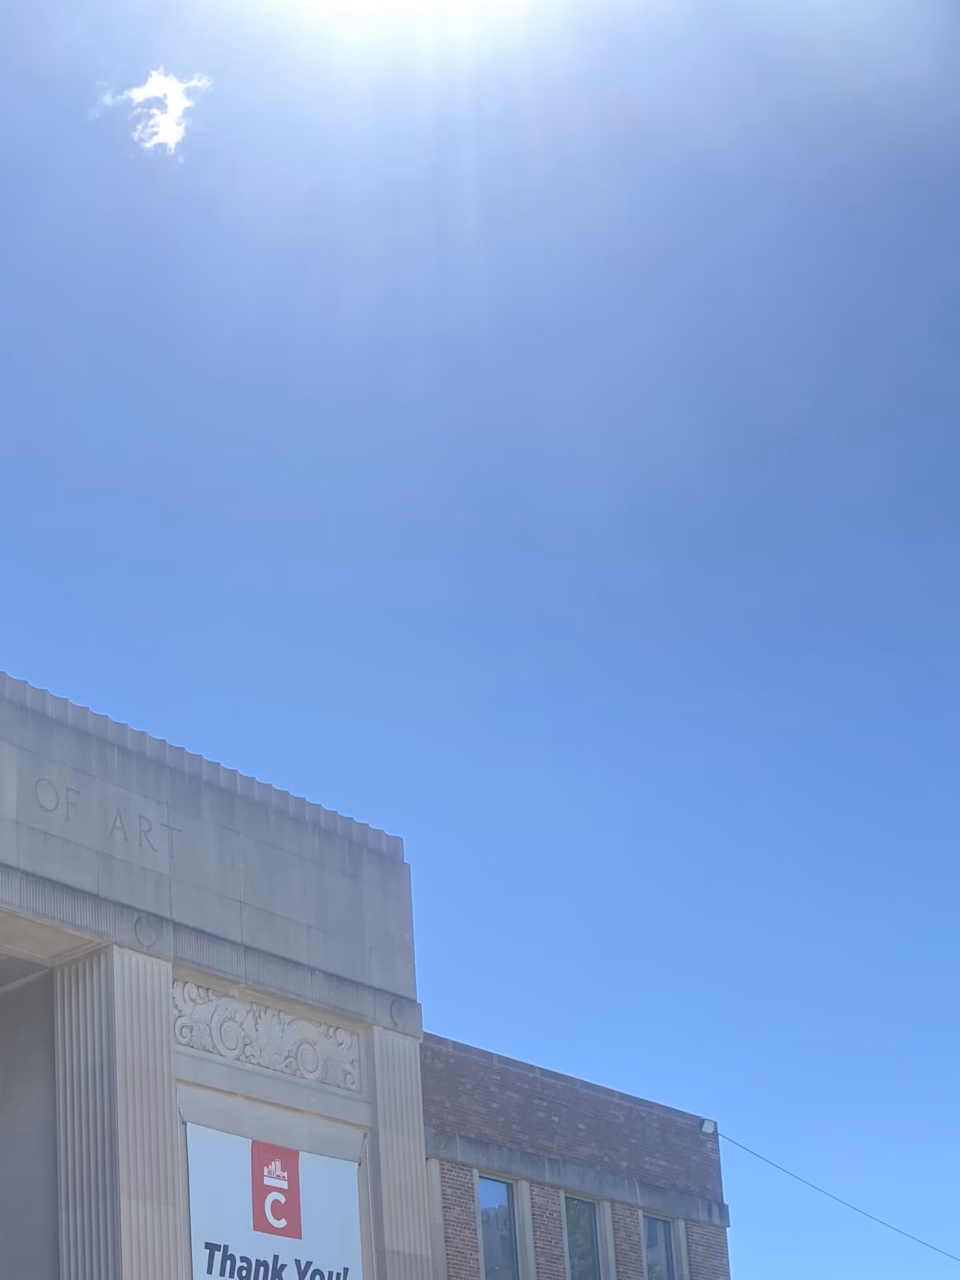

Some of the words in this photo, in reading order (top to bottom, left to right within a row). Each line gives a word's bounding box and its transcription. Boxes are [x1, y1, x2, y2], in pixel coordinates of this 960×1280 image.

[35, 778, 80, 822] OF
[110, 807, 182, 858] ART
[264, 1191, 288, 1229] C
